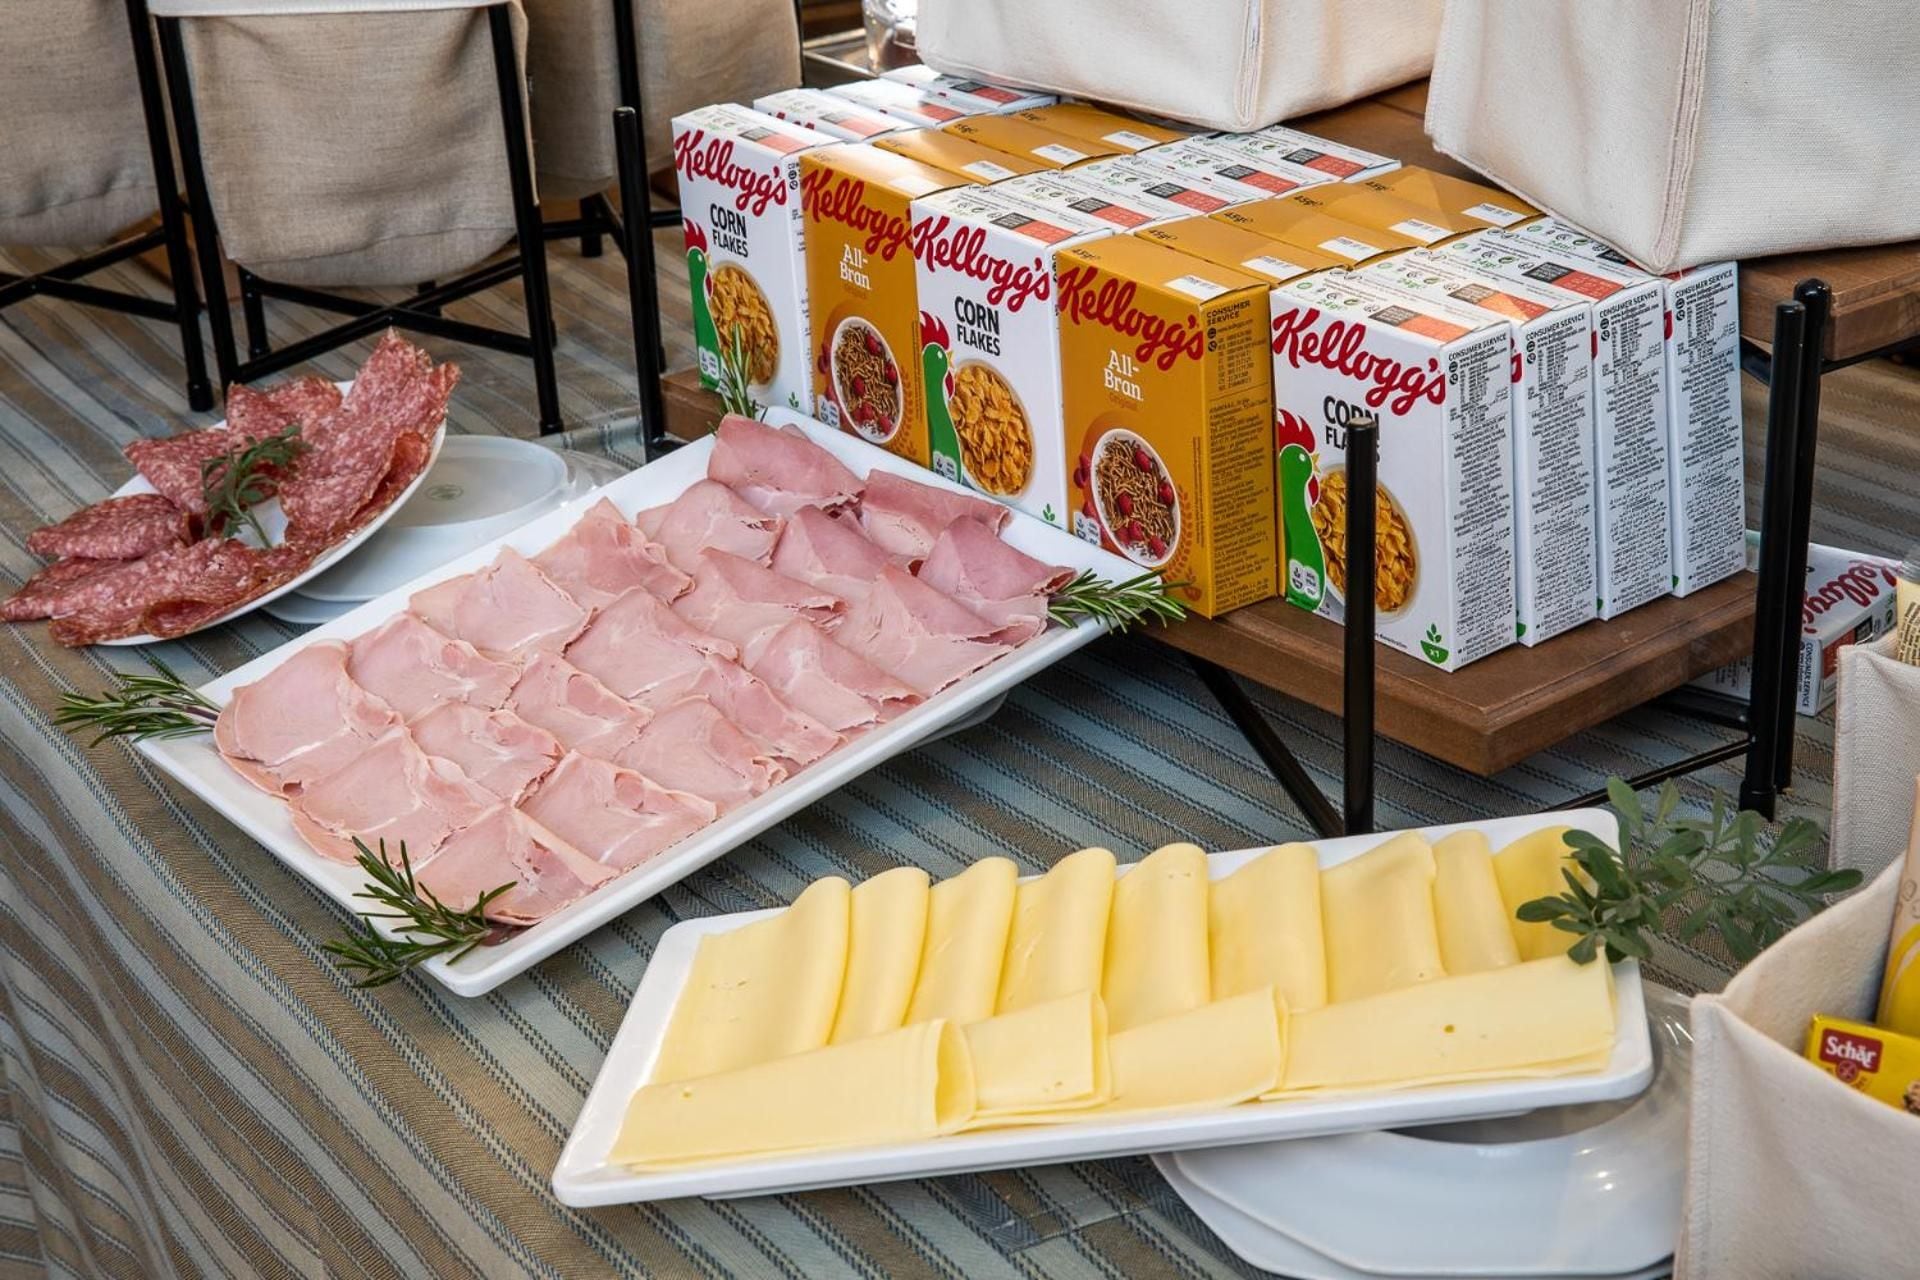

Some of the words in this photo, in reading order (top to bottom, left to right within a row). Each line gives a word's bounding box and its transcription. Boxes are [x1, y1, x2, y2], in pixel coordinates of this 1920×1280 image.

[675, 129, 787, 217] Kellogg's
[710, 203, 747, 239] CORN
[712, 228, 749, 258] FLAKES
[843, 243, 868, 268] All-
[840, 260, 871, 290] Bran
[913, 215, 1050, 312] Kellogg's
[955, 296, 1000, 336] CORN
[1058, 265, 1203, 371] Kellogg's
[1206, 300, 1250, 318] CONSUMER
[957, 323, 1001, 357] FLAKES
[1108, 349, 1140, 377] All-
[1271, 307, 1446, 416] Kellogg's
[1104, 367, 1144, 401] Bran
[1825, 1035, 1877, 1068] Schär
